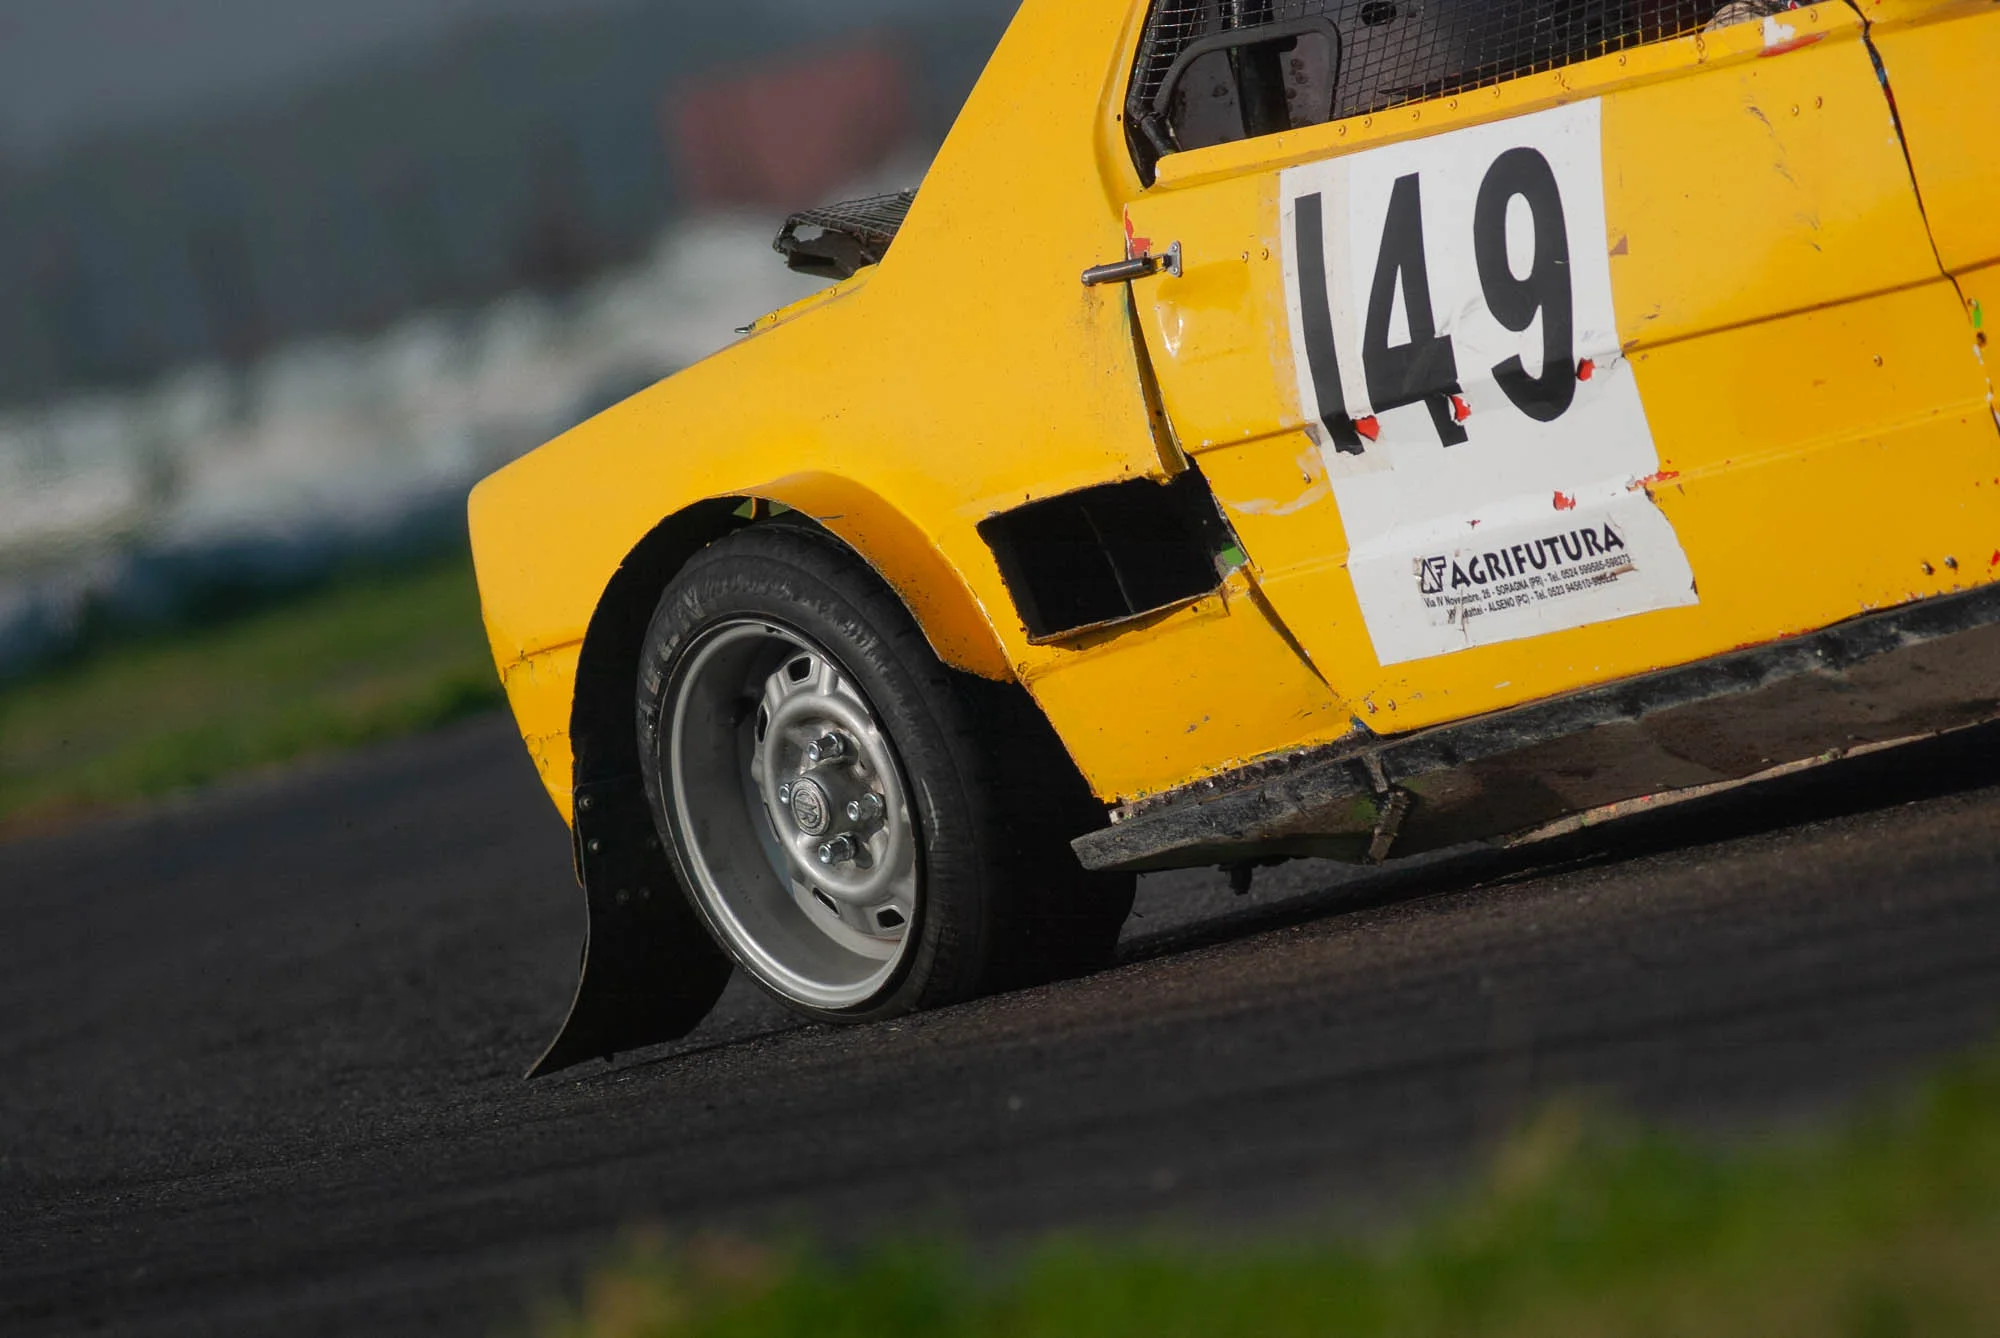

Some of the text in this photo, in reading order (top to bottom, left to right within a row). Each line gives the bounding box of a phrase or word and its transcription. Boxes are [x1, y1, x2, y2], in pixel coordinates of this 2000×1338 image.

[1294, 146, 1577, 456] 149
[1451, 522, 1625, 590] AGRIFUTURA
[1424, 597, 1437, 608] Via
[1496, 579, 1530, 596] SORAGNA
[1548, 571, 1563, 583] Tel.
[1561, 567, 1580, 580] 0524
[1489, 596, 1516, 612] ALSENO
[1516, 592, 1532, 607] (PC)
[1534, 588, 1549, 601] Tel.
